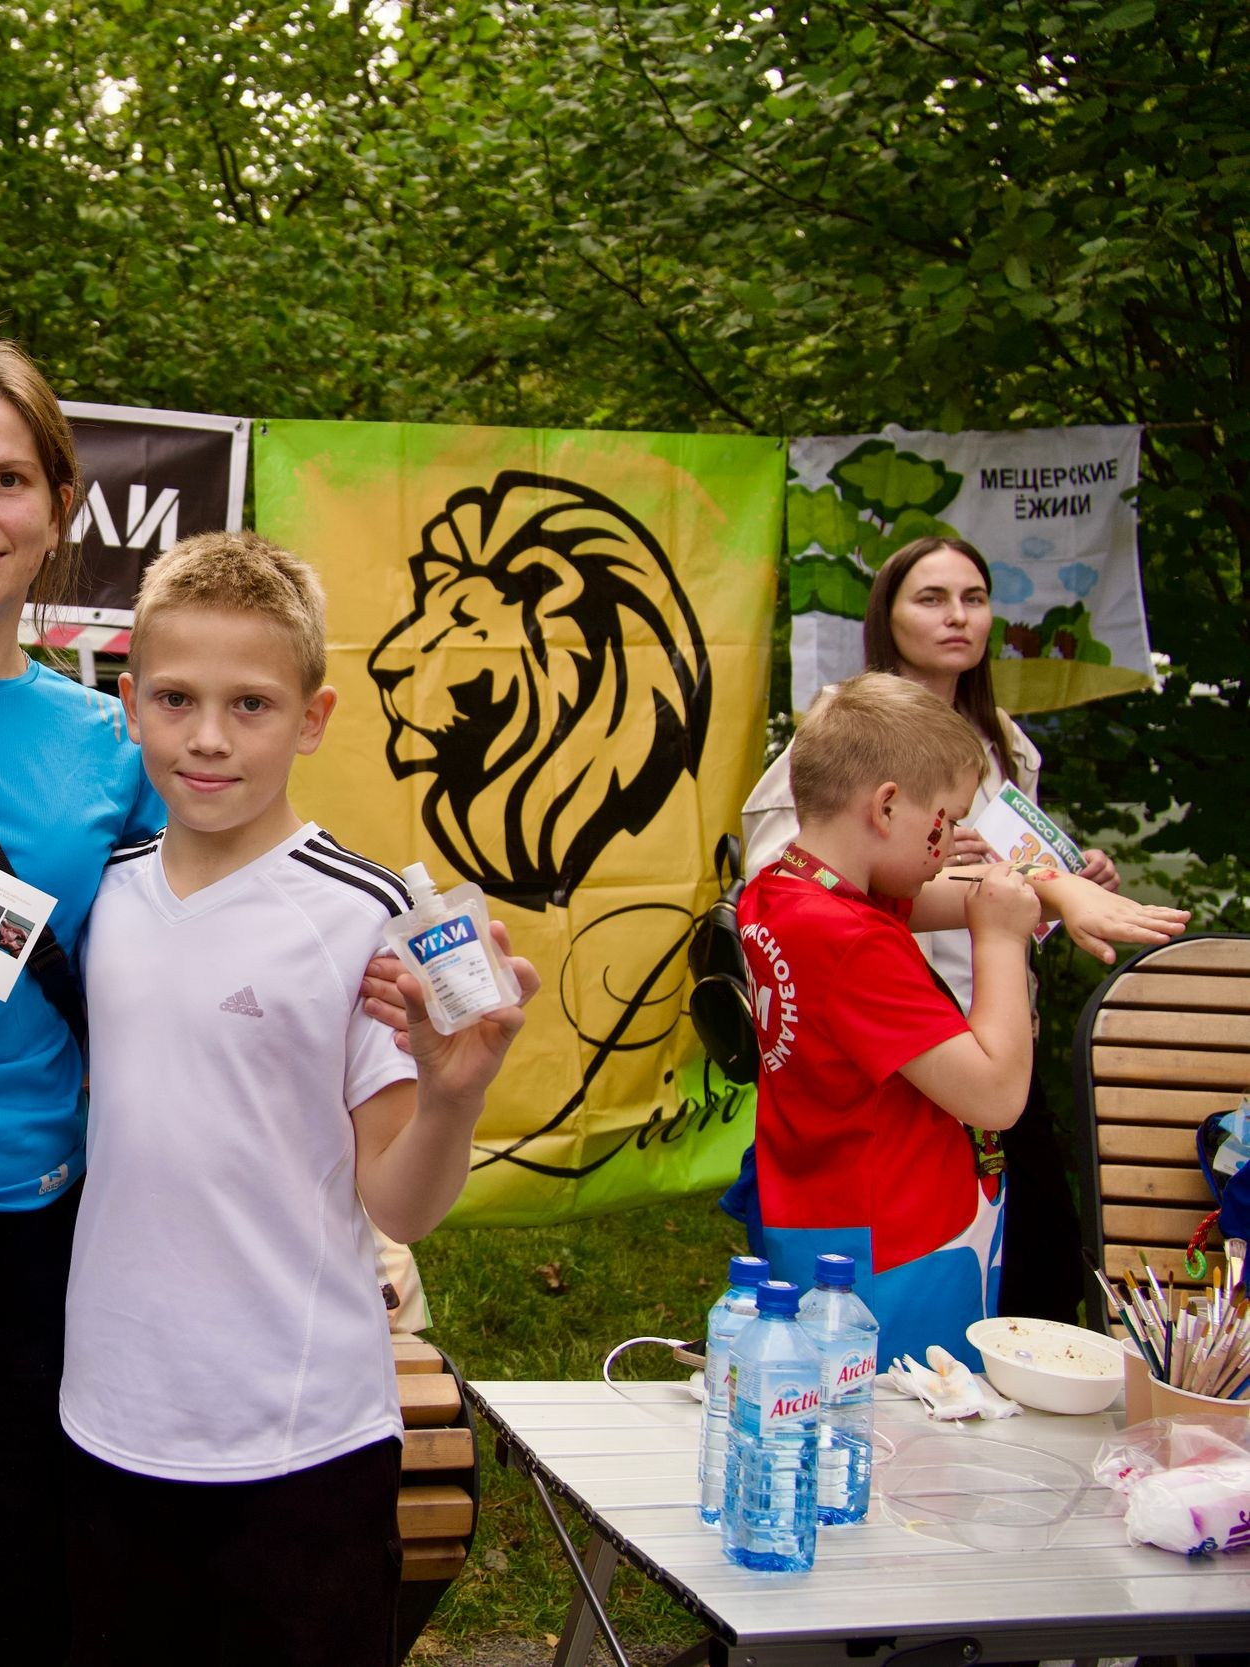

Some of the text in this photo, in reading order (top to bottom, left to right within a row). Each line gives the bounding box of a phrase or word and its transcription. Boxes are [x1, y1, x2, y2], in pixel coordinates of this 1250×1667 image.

[980, 458, 1118, 492] МЕЩЕРСКИЕ
[65, 479, 180, 553] ЛИ
[1011, 796, 1055, 841] КРОСС
[414, 922, 469, 957] УГЛИ
[836, 1354, 876, 1386] Arctic
[769, 1389, 821, 1420] Arctic
